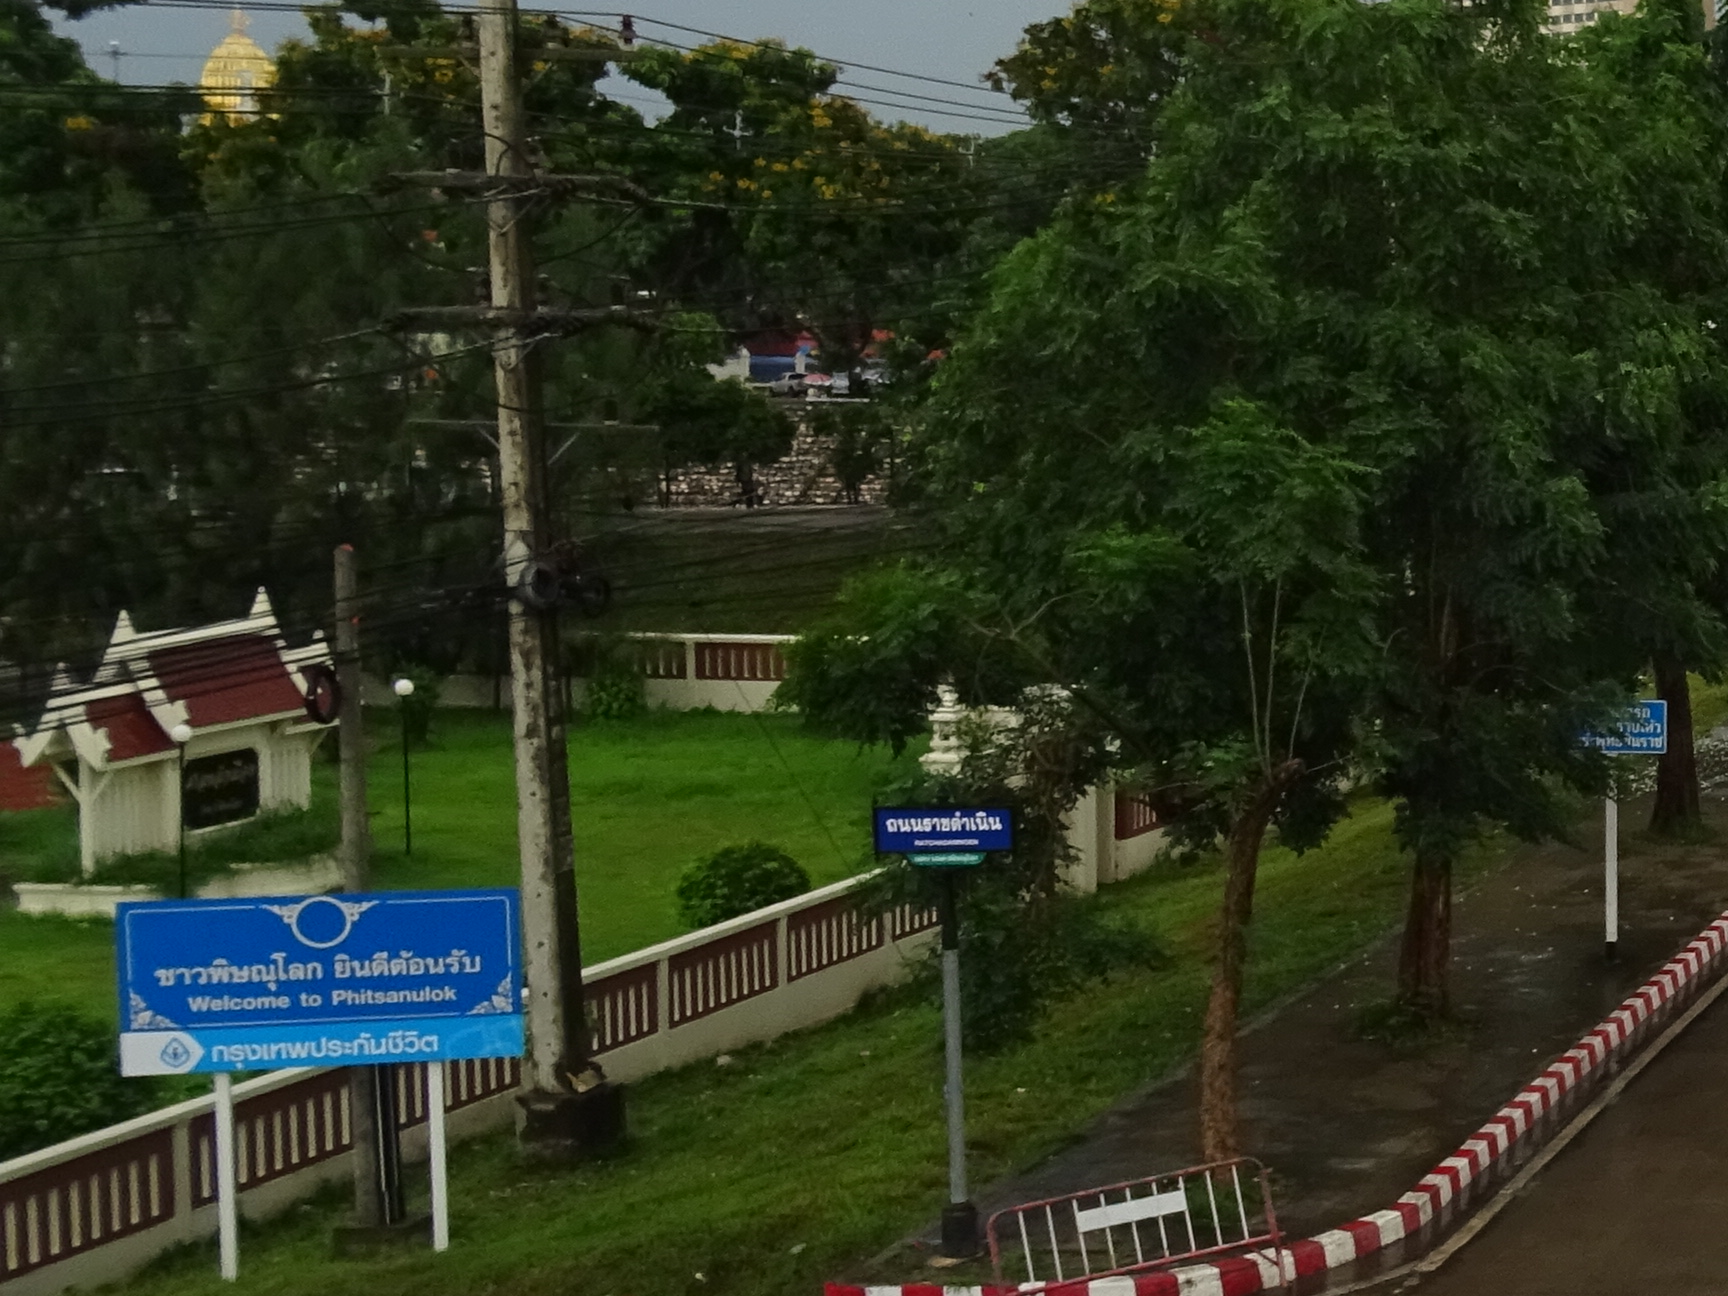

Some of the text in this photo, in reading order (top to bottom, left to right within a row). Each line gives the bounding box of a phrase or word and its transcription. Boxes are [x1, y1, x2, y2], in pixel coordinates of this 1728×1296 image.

[154, 948, 482, 991] ชาวพิษณุโลก ยินดีต้อนรับ
[188, 985, 457, 1013] Welcome to Phitsanulok
[211, 1032, 440, 1071] กรุงเทพประกันชีวิต
